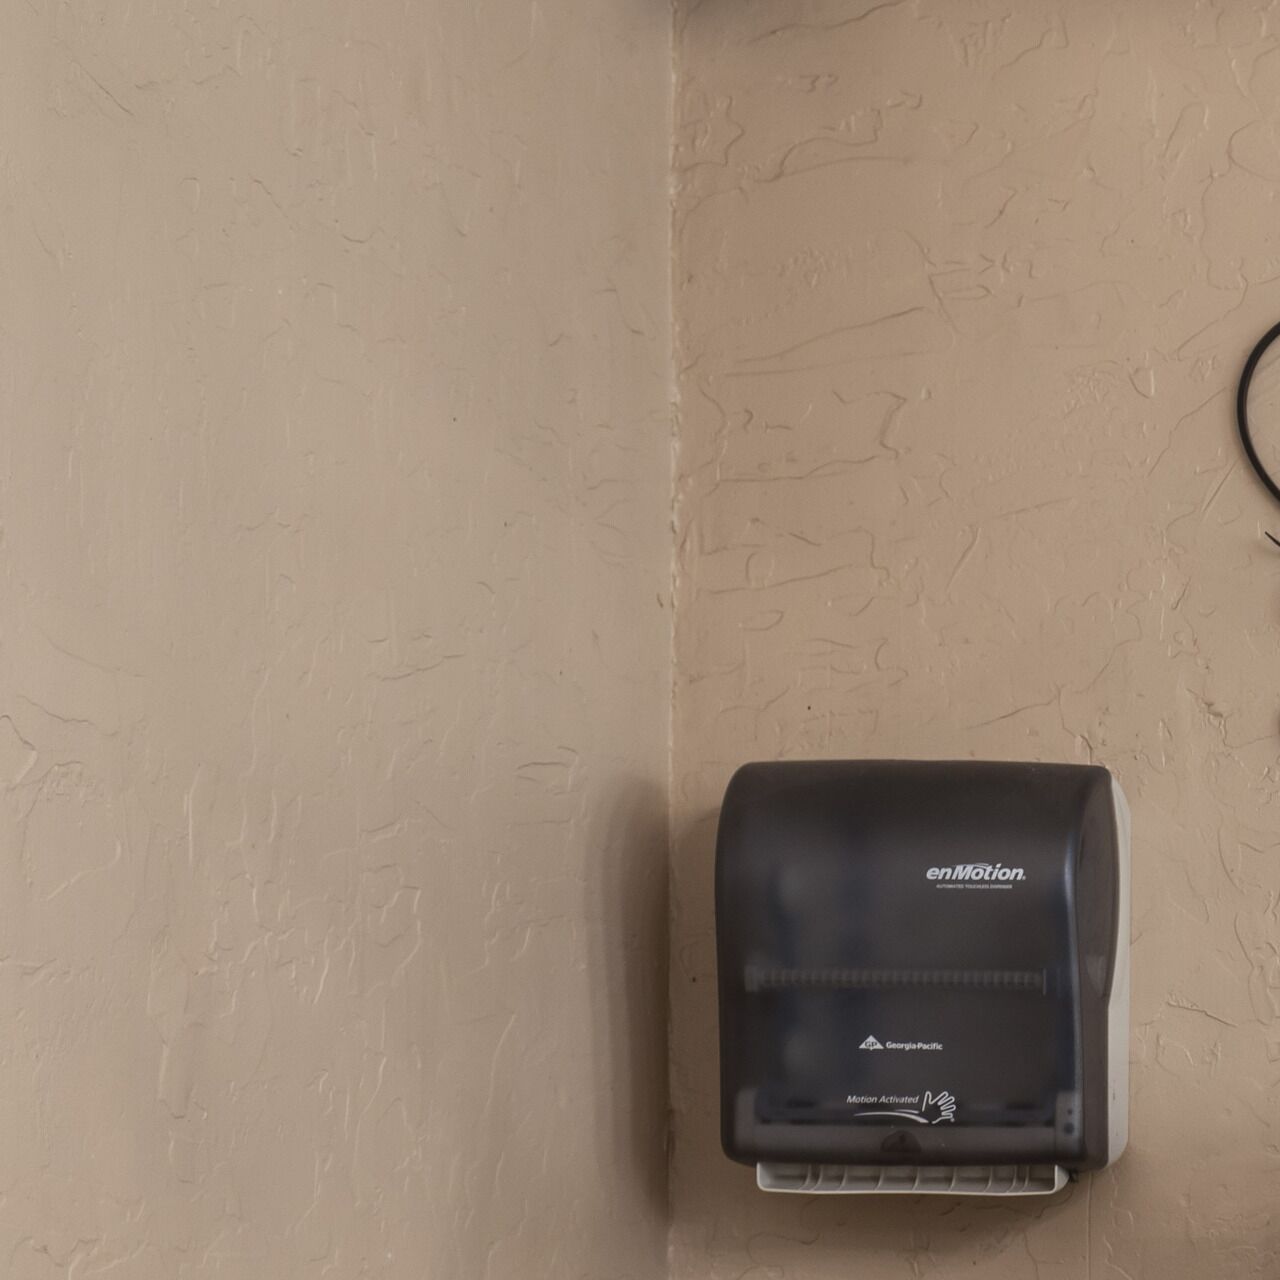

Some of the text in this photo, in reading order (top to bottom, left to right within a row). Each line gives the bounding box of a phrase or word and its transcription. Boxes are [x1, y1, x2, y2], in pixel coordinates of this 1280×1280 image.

[926, 863, 1024, 880] enMotion
[847, 1095, 920, 1103] Motion Activated
